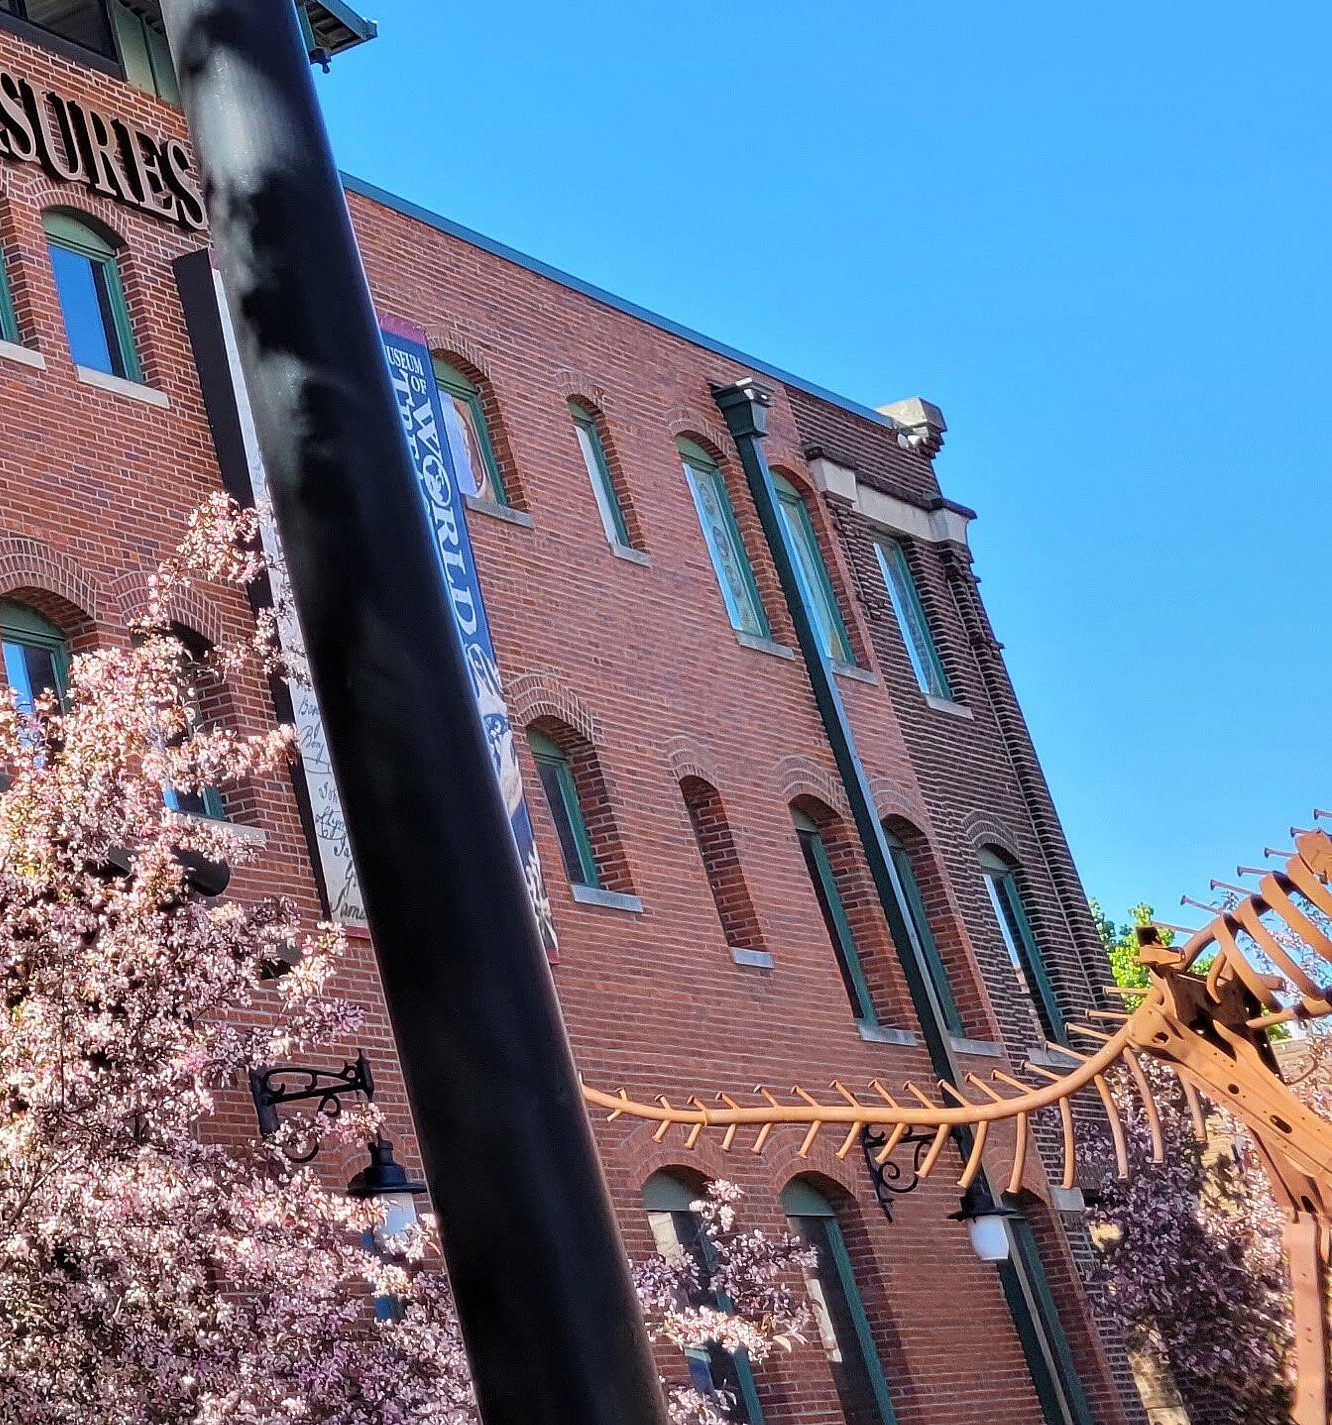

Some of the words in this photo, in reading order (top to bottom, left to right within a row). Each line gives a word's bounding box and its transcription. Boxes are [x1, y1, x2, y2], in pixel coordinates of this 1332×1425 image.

[385, 345, 424, 376] USEUM
[411, 375, 427, 396] OF
[413, 398, 477, 636] WORLD
